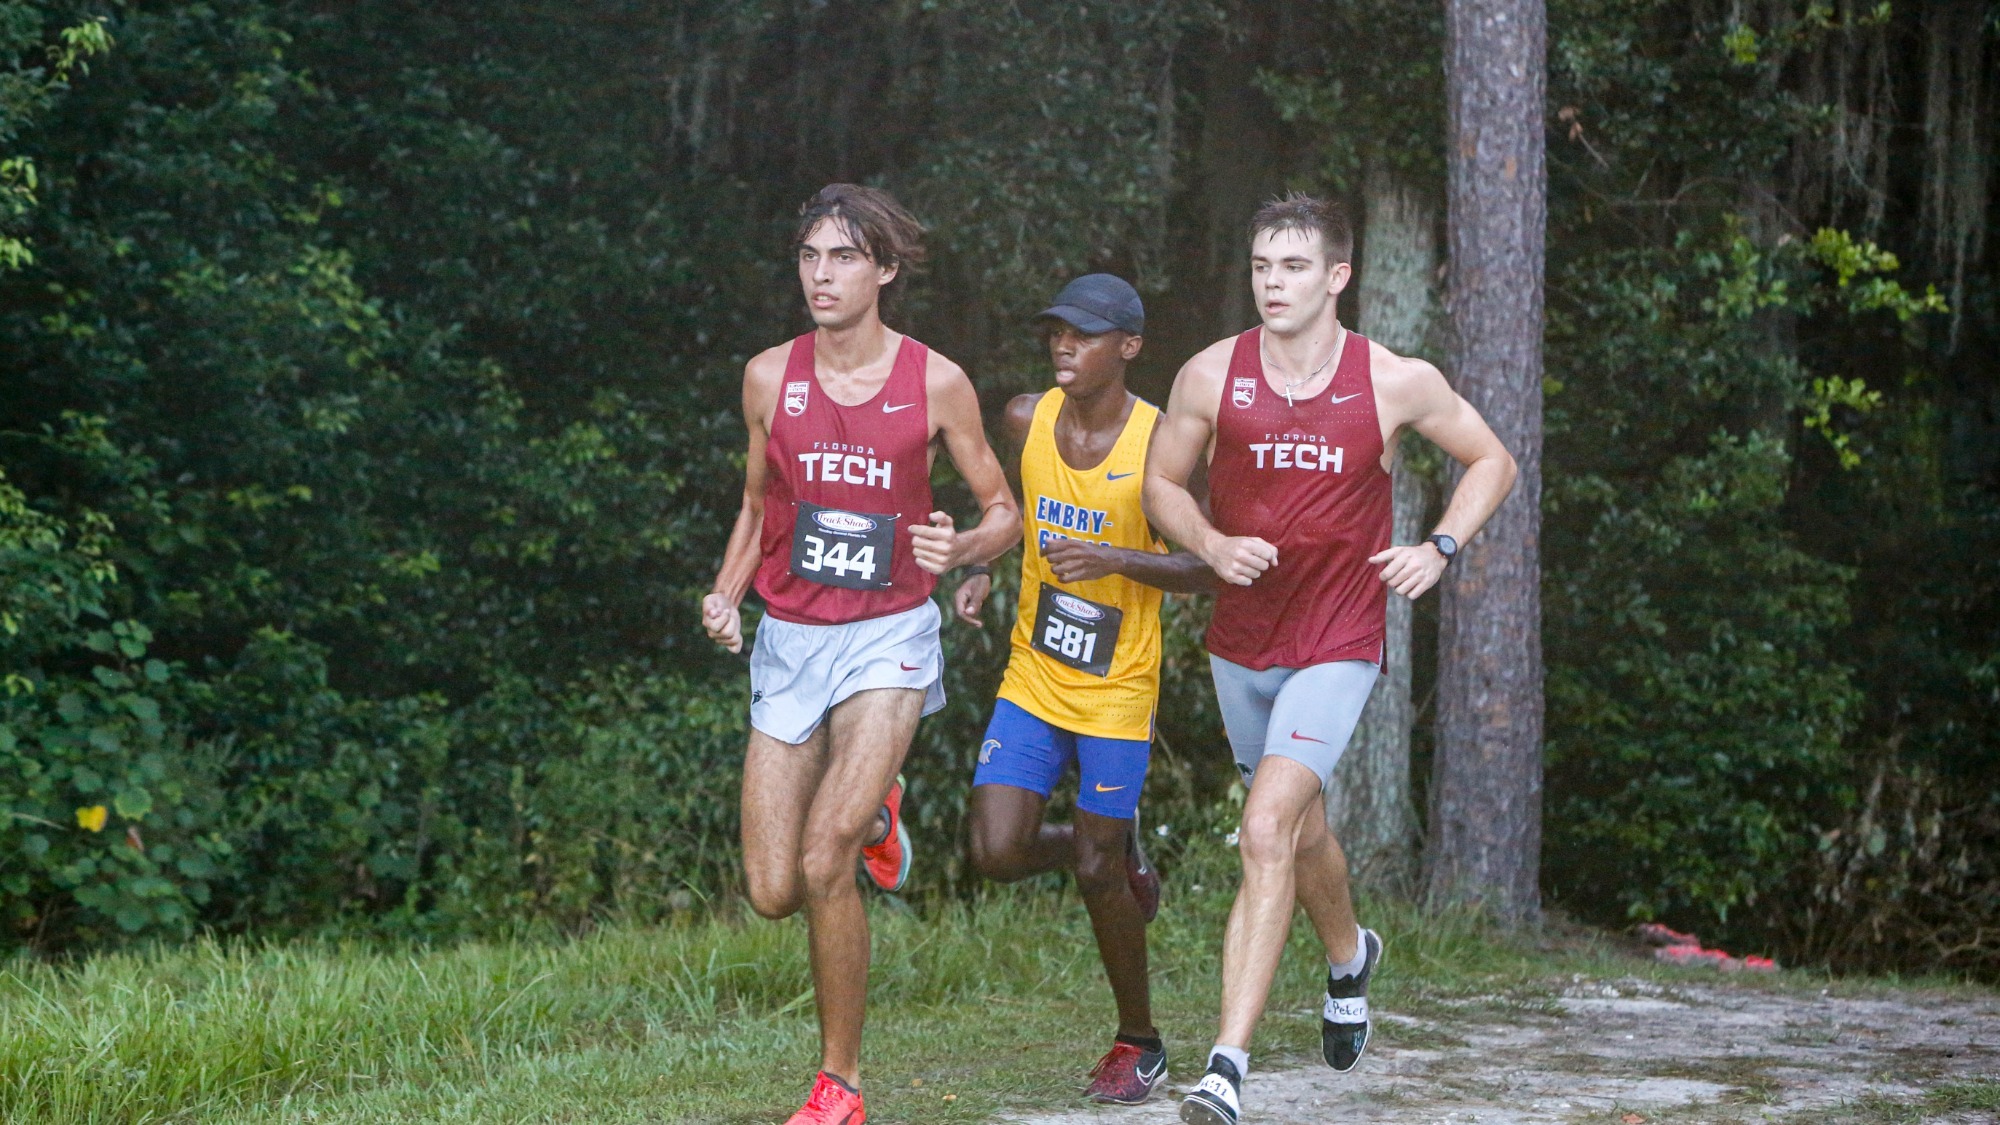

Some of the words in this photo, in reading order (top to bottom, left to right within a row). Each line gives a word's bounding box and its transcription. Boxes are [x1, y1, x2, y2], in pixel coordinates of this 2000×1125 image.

[814, 442, 875, 455] FLORIDA
[1265, 433, 1327, 443] FLORIDA
[798, 452, 892, 490] TECH
[1248, 443, 1344, 474] TECH
[818, 512, 843, 526] Track
[842, 517, 873, 529] Shack
[1036, 494, 1114, 535] EMBRY-
[801, 534, 876, 581] 344
[1056, 595, 1076, 610] Track
[1076, 603, 1101, 618] Shack
[1043, 615, 1098, 663] 281
[1332, 1000, 1364, 1016] Peter
